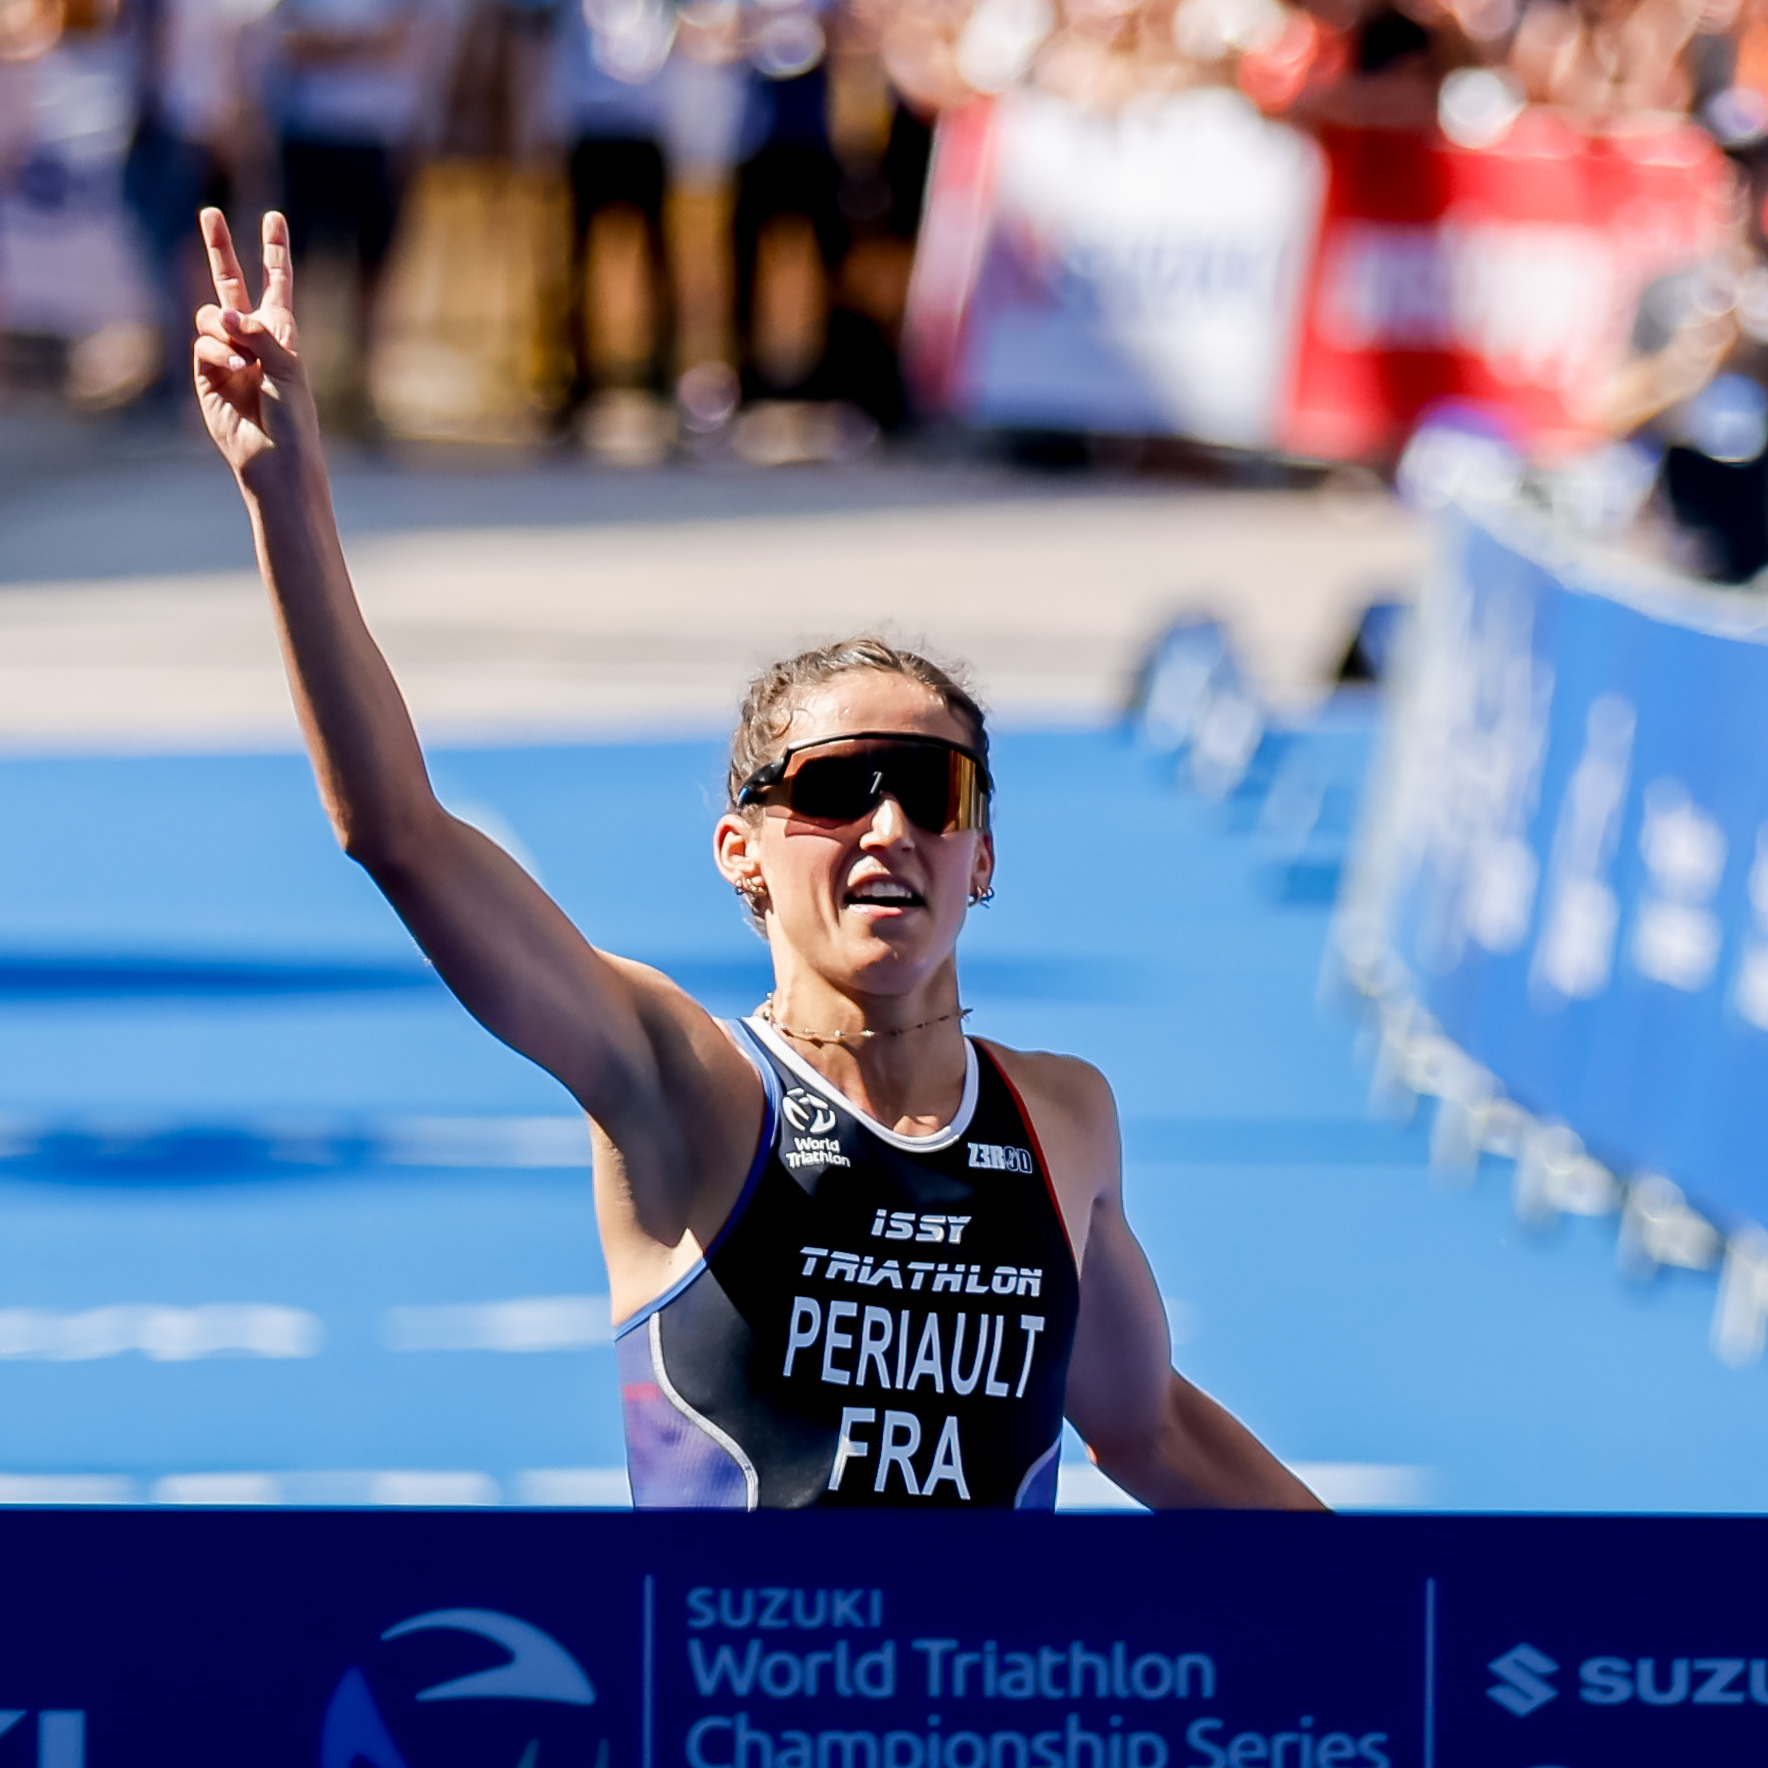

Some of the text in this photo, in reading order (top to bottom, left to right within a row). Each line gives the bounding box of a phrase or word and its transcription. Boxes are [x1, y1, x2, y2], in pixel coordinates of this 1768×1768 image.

[786, 1151, 851, 1169] Triathlon
[794, 1136, 840, 1154] World
[783, 1296, 1045, 1398] PERIAULT
[828, 1407, 971, 1500] FRA
[687, 1587, 882, 1629] SUZUKI
[688, 1638, 1215, 1700] World Triathlon
